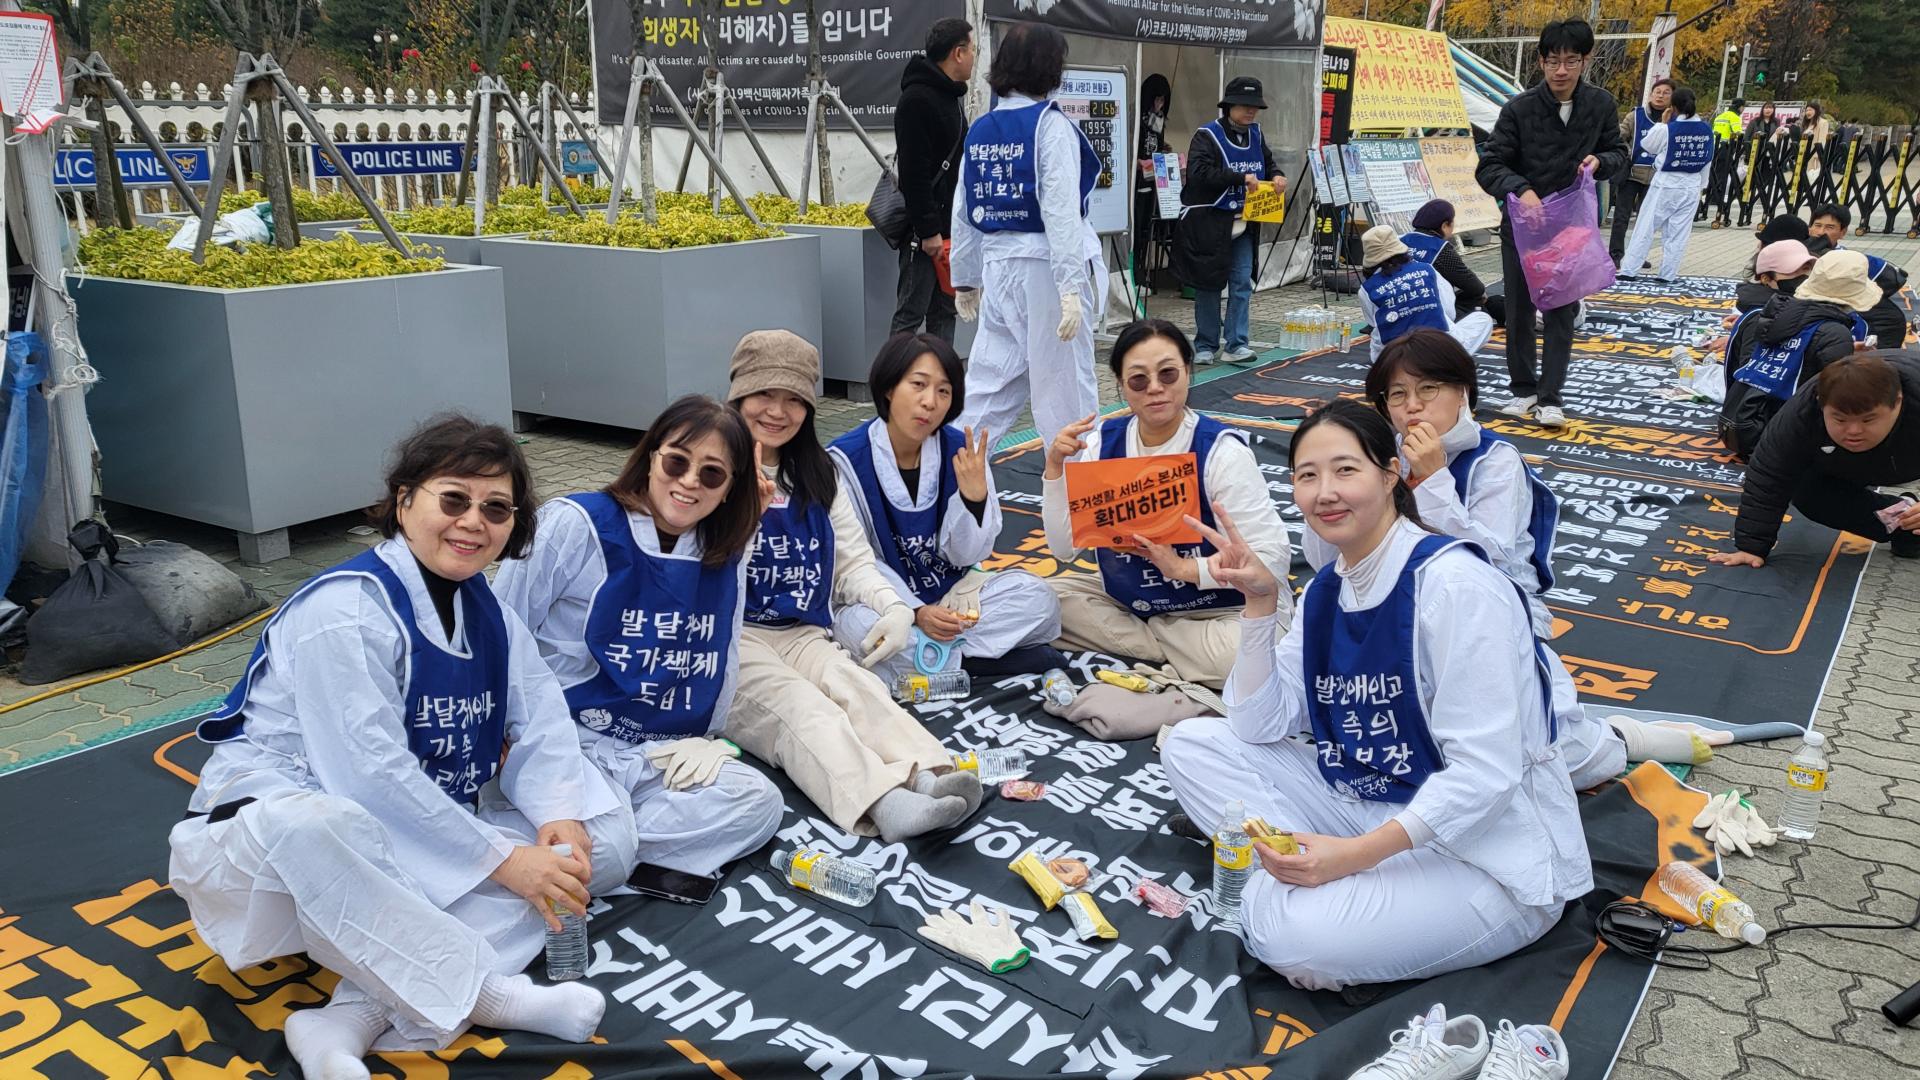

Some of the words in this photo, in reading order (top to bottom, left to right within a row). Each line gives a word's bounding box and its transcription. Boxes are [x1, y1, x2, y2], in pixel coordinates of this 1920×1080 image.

[1160, 1, 1170, 13] for
[1171, 4, 1182, 14] the
[1206, 8, 1213, 17] of
[659, 54, 695, 65] disaster.
[716, 55, 743, 65] ictims
[746, 57, 760, 65] are
[762, 54, 794, 65] caused
[796, 53, 807, 66] by
[820, 50, 873, 64] esponsible
[876, 49, 927, 61] Governme
[764, 105, 807, 115] COVID-19
[866, 104, 897, 114] Victim
[54, 157, 94, 178] LIC
[117, 157, 167, 176] LINE
[352, 153, 413, 170] POLICE
[417, 151, 453, 167] LINE
[1069, 491, 1116, 514] 주거생활
[1119, 477, 1155, 500] 서비스
[1158, 461, 1195, 484] 본사업
[1094, 483, 1188, 528] 확대하라!
[617, 715, 643, 731] 사단법인
